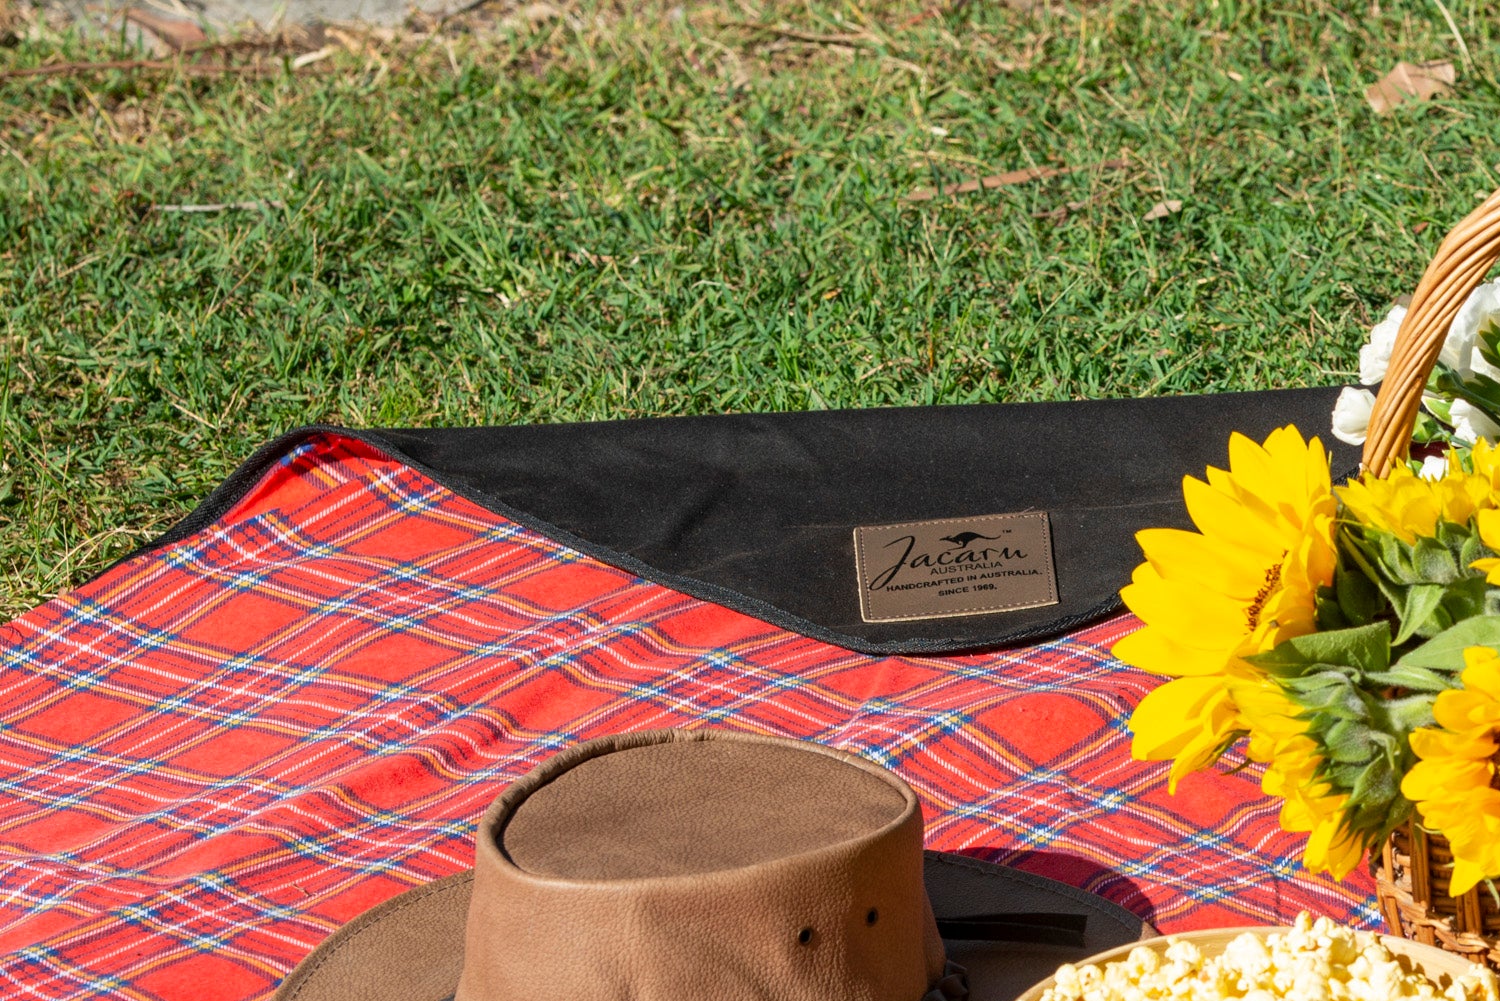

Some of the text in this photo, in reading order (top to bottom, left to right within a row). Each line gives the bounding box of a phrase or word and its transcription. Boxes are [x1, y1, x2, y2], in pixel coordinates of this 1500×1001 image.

[869, 535, 1028, 591] Jacaru
[929, 561, 1004, 576] AUSTRALIA
[886, 569, 1043, 592] HANDCRAFTED IN AUSTRALIA.
[938, 586, 970, 597] SINCE
